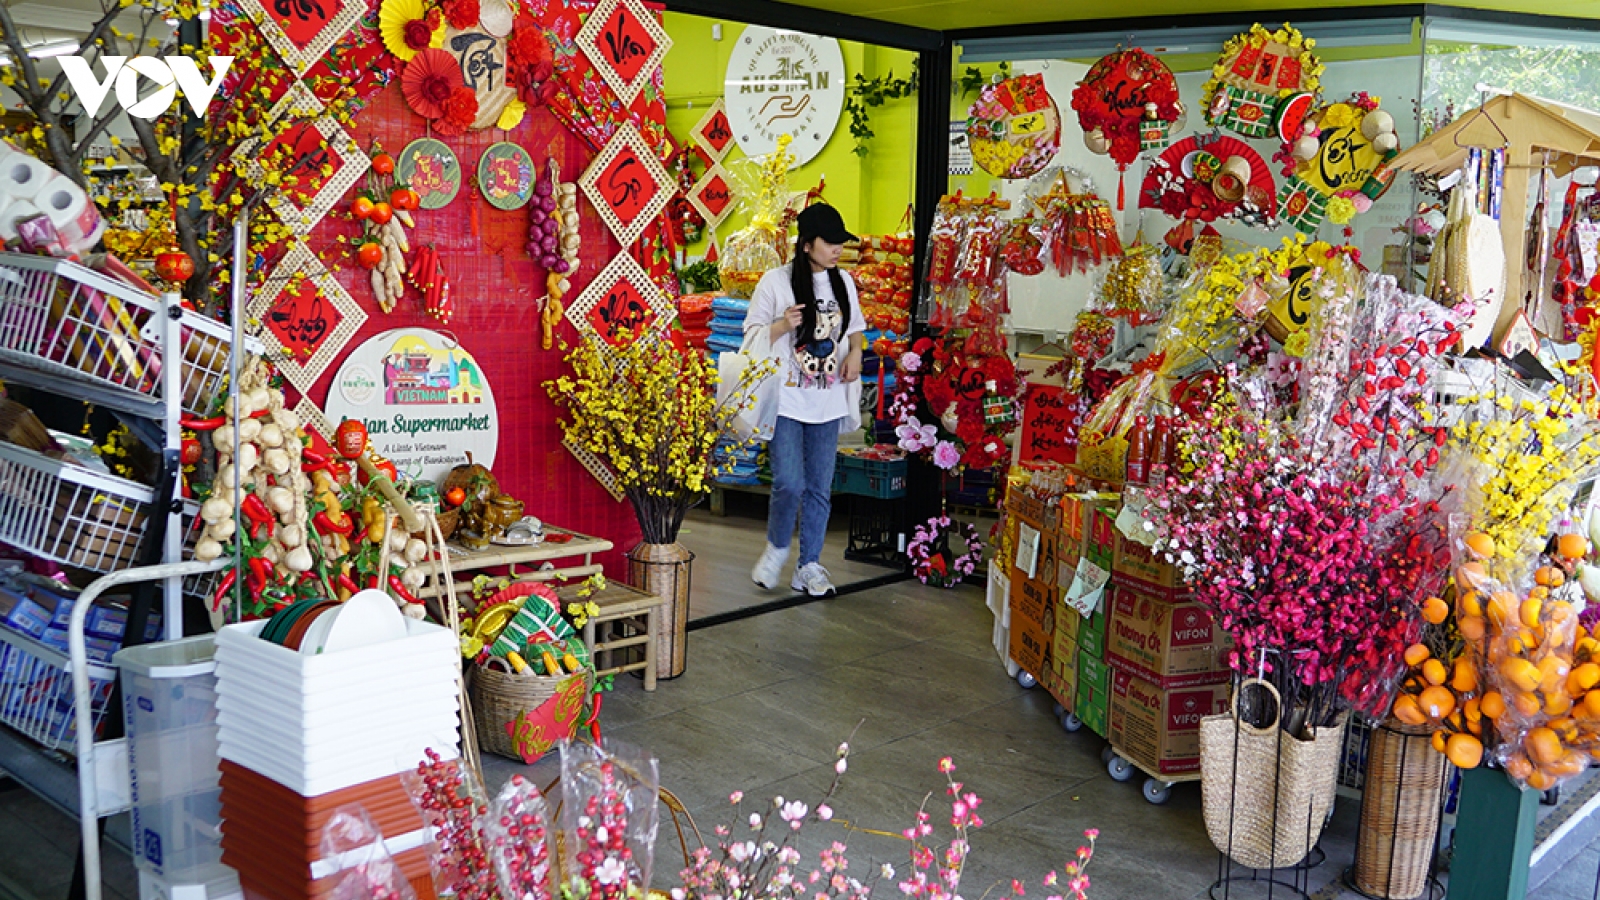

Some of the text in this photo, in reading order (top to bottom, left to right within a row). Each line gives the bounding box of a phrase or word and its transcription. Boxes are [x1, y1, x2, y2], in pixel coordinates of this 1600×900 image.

[397, 389, 448, 402] VIETNAM
[391, 412, 490, 438] Supermarket
[383, 443, 447, 453] A Little Vietnam
[424, 455, 466, 465] Bankstown
[1175, 628, 1209, 640] VIFON
[1173, 713, 1202, 725] VIFO
